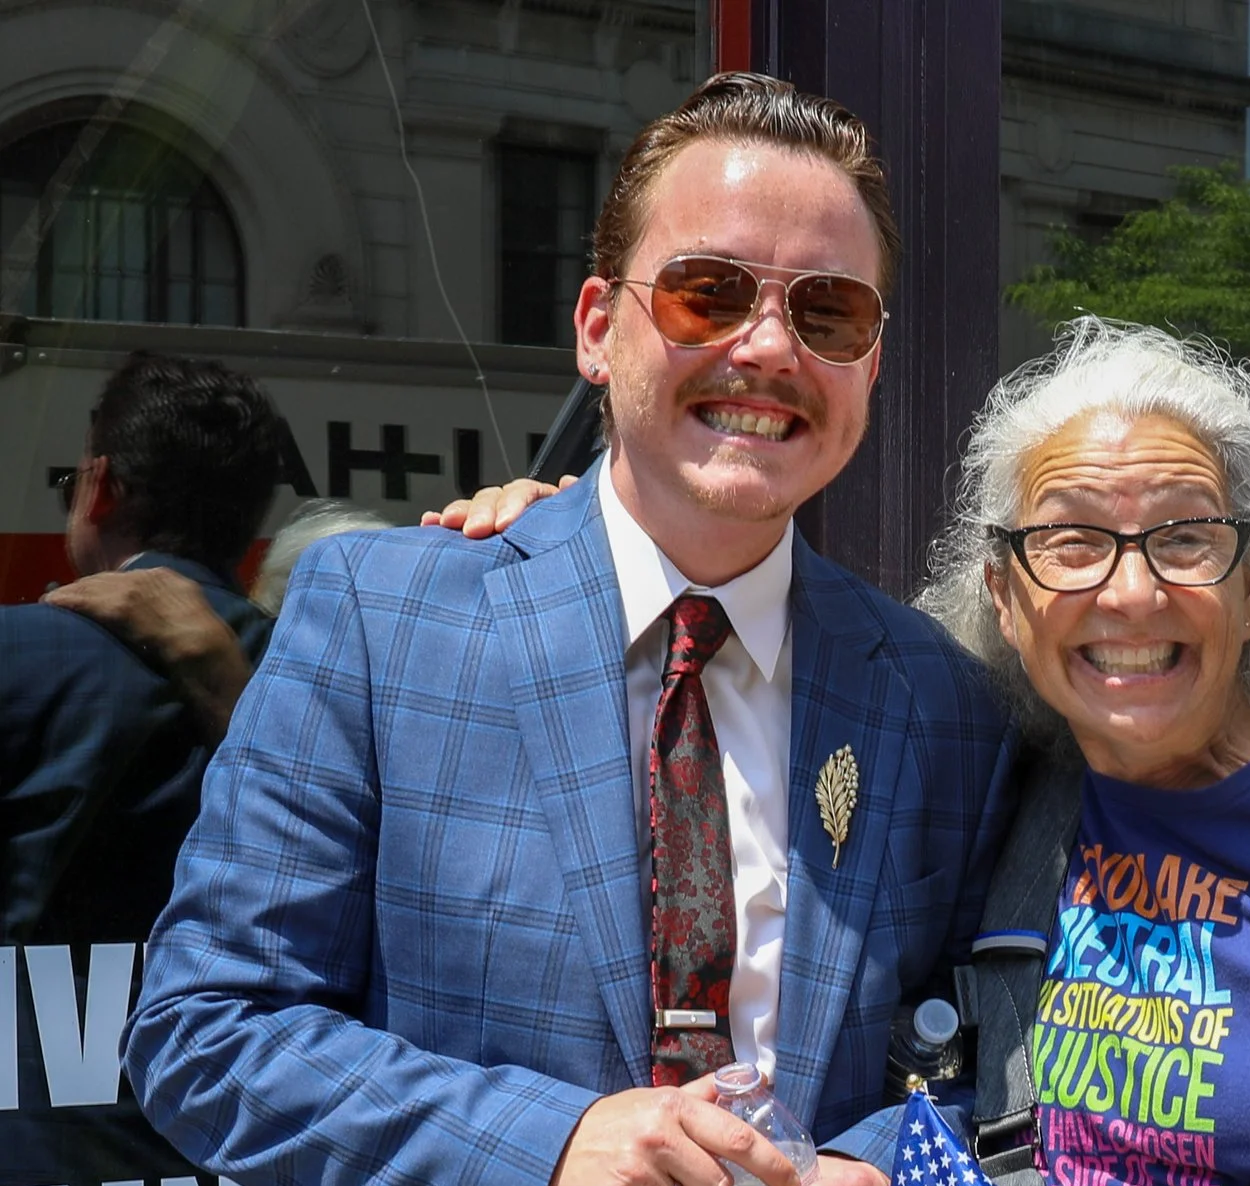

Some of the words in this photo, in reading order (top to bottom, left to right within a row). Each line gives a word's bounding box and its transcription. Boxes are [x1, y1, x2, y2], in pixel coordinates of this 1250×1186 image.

[1048, 906, 1232, 1005] NEUTRAL
[1052, 982, 1190, 1045] SITUATIONS
[1190, 1007, 1233, 1050] OF
